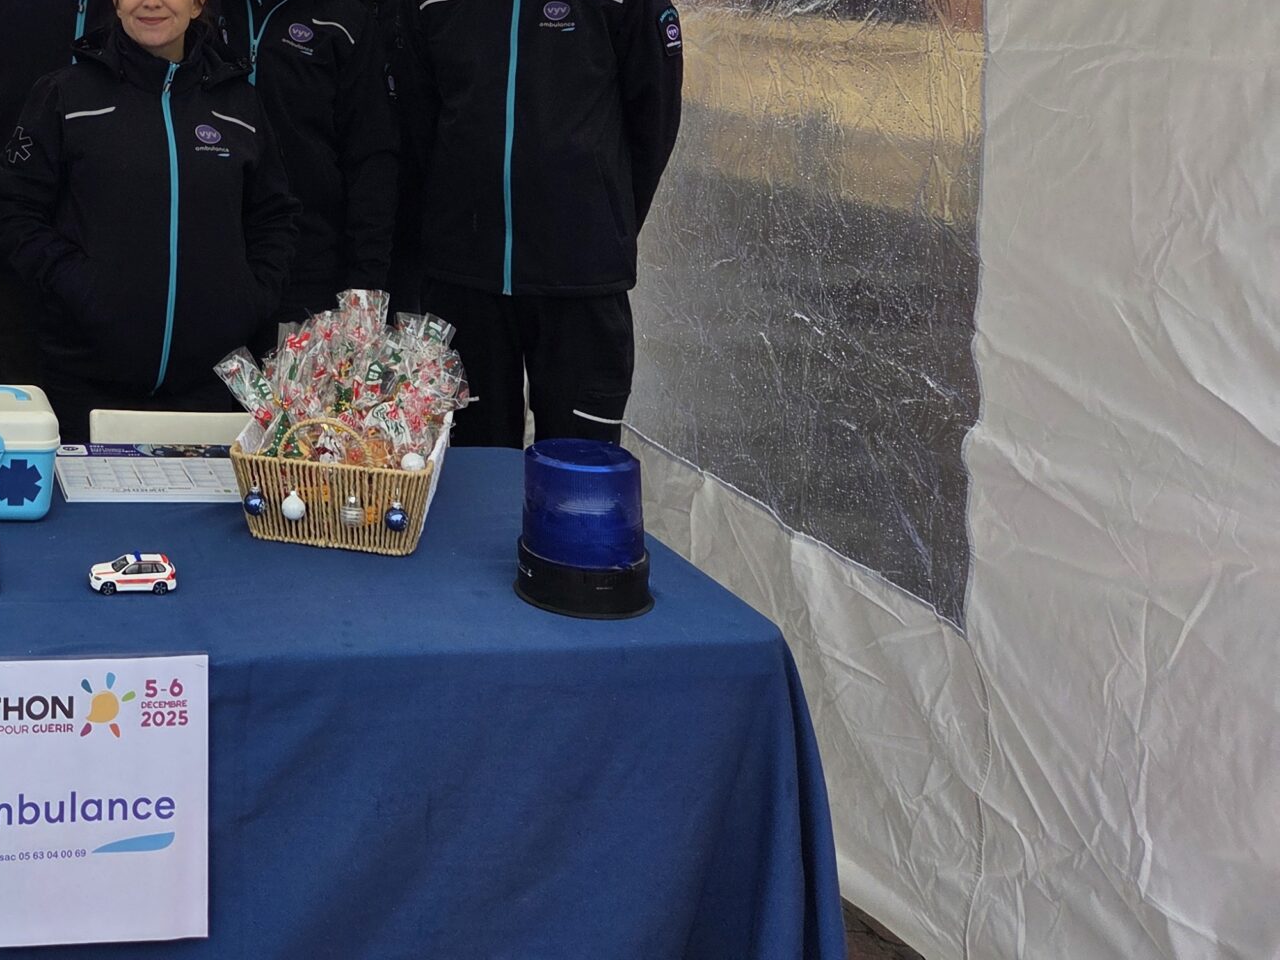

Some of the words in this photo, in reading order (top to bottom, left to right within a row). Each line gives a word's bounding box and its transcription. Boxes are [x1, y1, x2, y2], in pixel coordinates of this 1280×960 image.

[547, 6, 567, 16] vyv
[292, 28, 311, 38] vyv
[199, 130, 217, 140] vyv
[140, 710, 190, 728] 2025
[18, 850, 31, 862] 05
[32, 850, 45, 861] 63
[46, 849, 59, 861] 04
[60, 849, 73, 860] 00
[74, 848, 87, 860] 69
